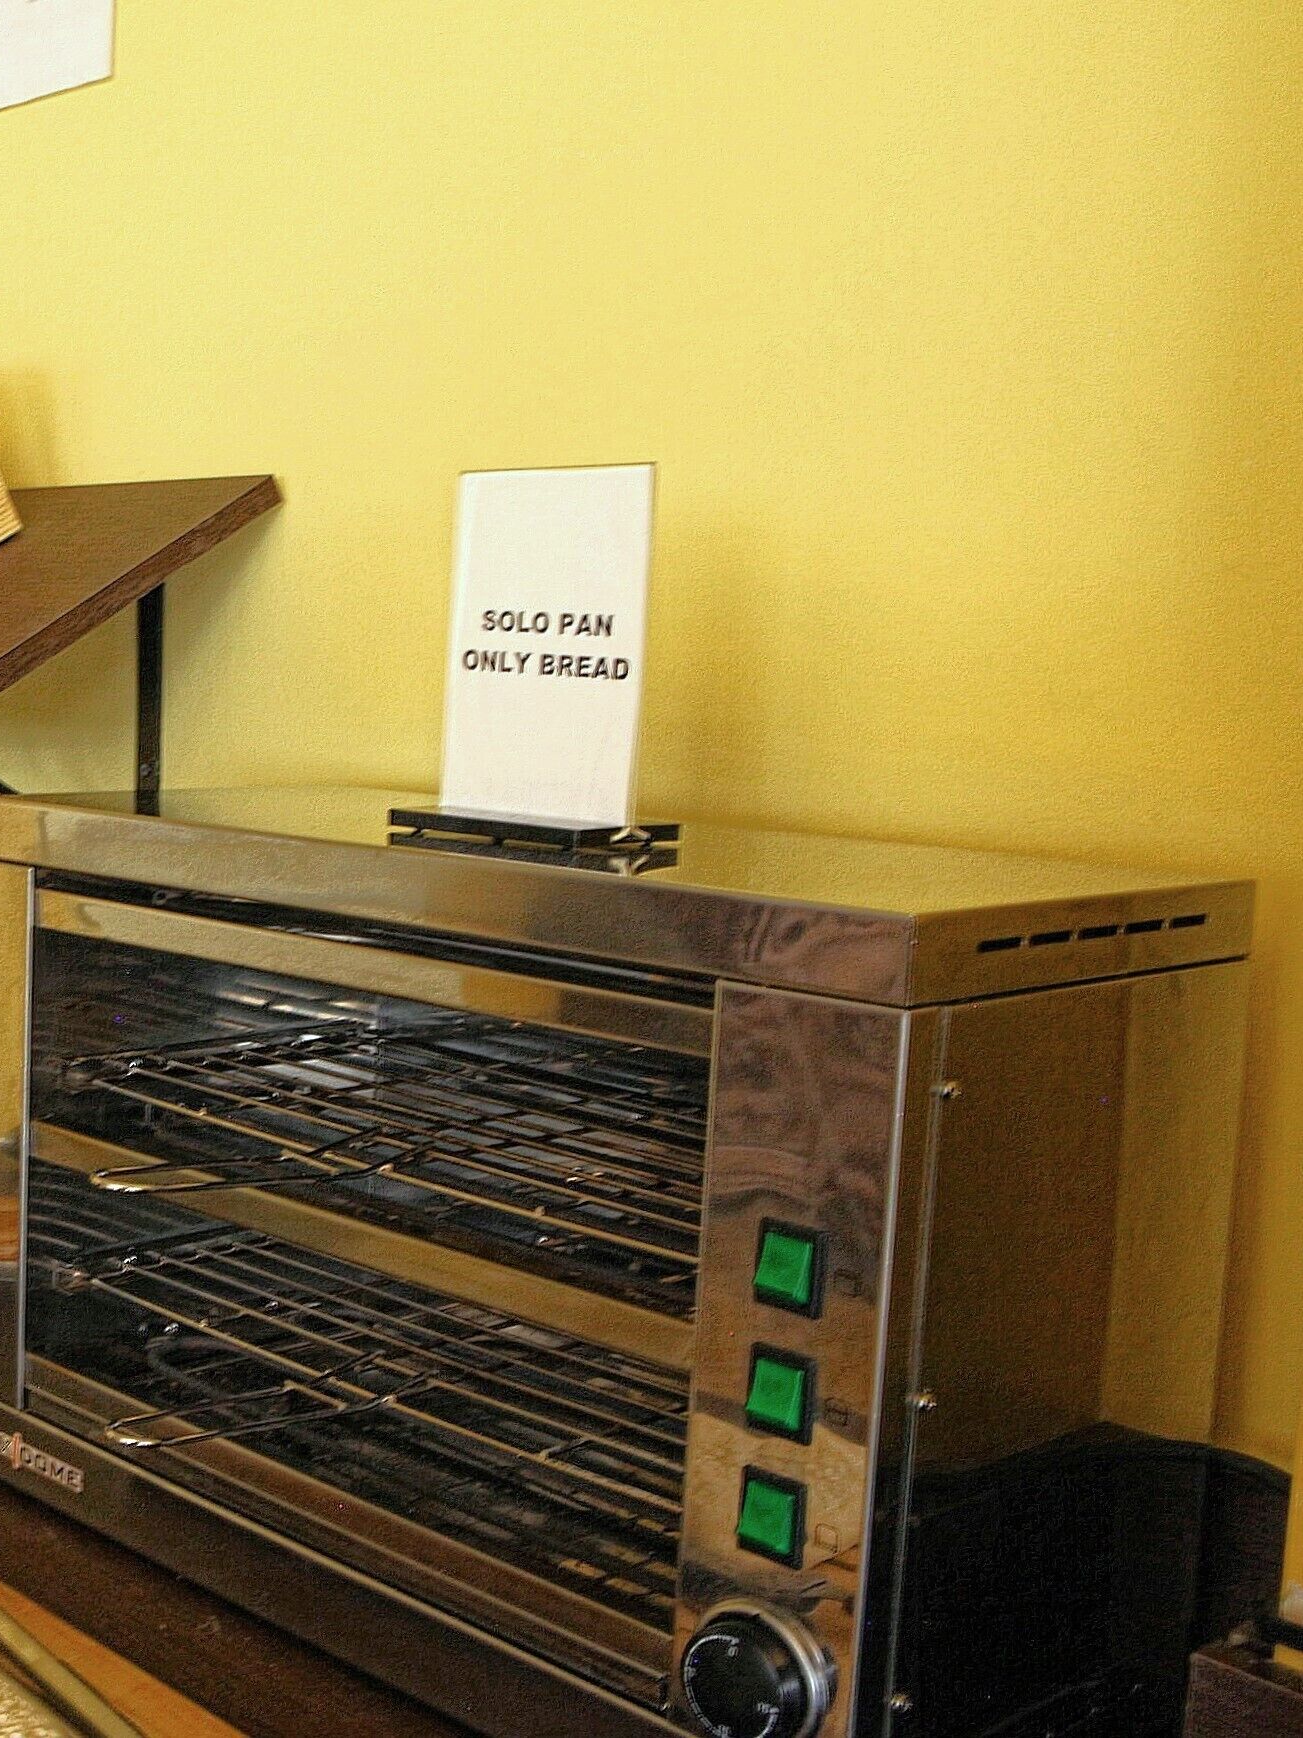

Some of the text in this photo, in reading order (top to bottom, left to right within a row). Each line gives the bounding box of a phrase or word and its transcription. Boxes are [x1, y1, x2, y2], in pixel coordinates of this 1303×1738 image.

[481, 609, 614, 637] SOLO PAN
[462, 649, 629, 680] ONLY BREAD
